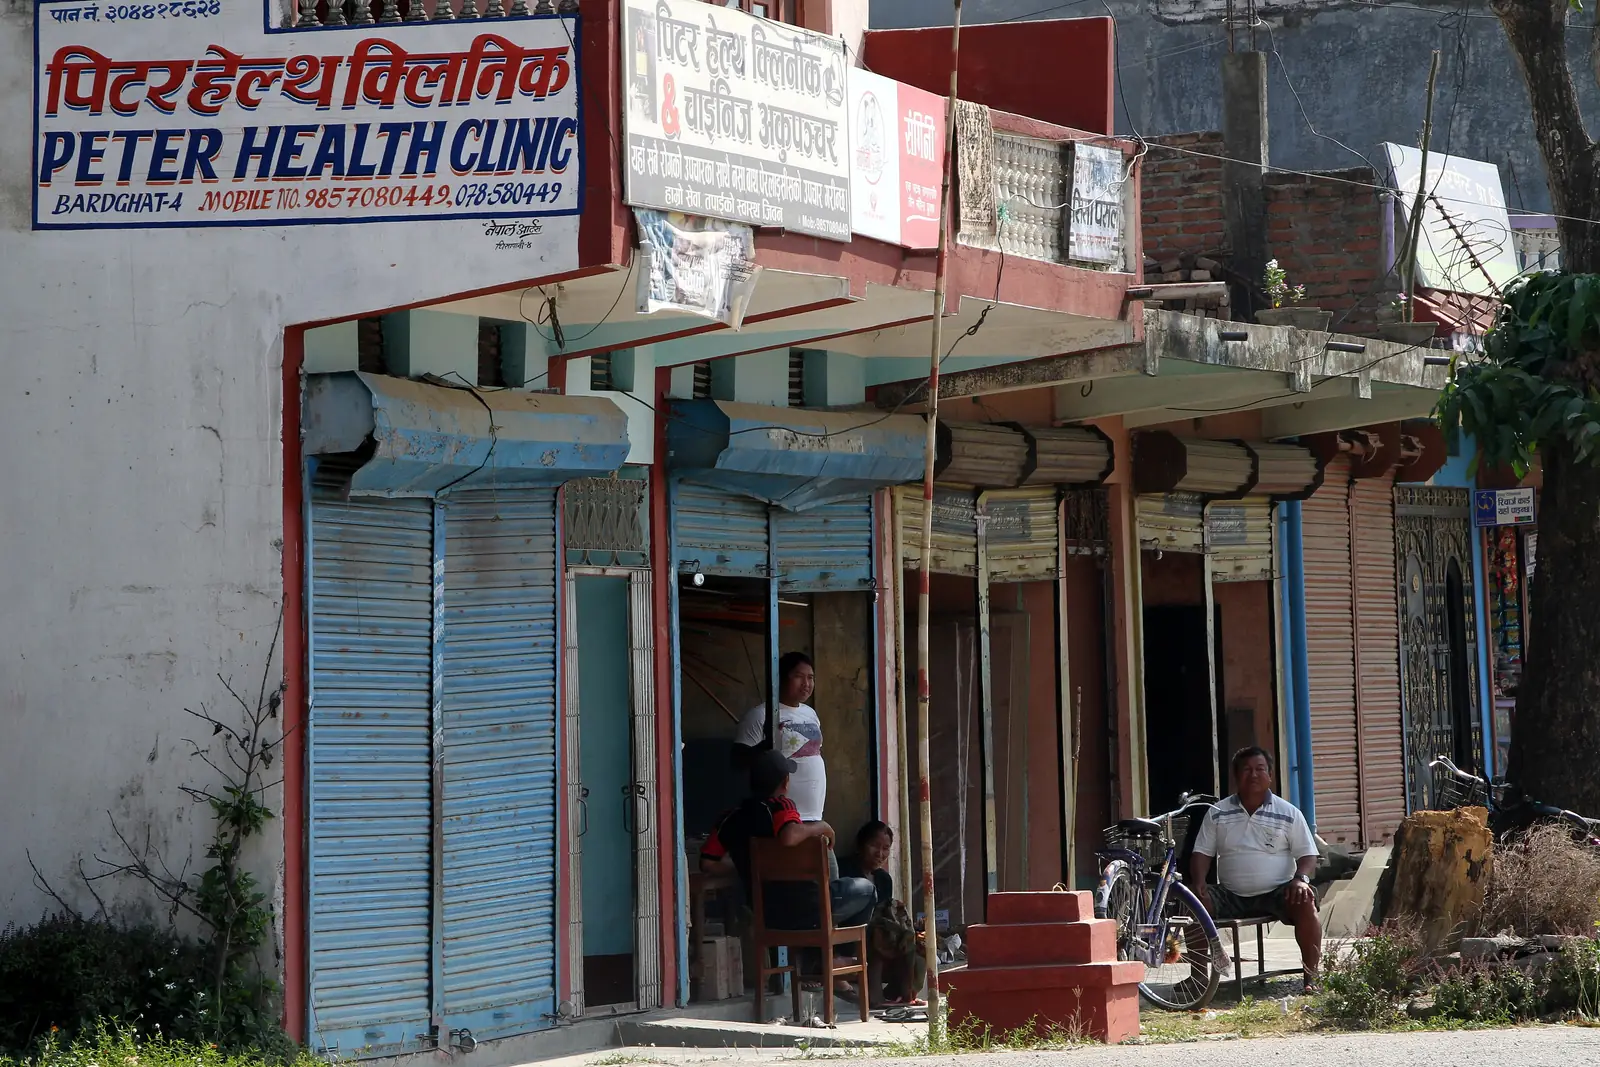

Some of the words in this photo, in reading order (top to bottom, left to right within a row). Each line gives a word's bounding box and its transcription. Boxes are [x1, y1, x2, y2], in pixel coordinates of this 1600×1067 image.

[50, 8, 82, 24] पान
[656, 0, 701, 73] पिटर
[705, 13, 747, 80] हेल्थ
[45, 44, 195, 116] पिटर
[187, 44, 343, 115] हेल्थ
[342, 33, 572, 110] क्लिनिक
[661, 73, 681, 139] &
[39, 127, 224, 188] PETER
[232, 120, 449, 183] HEALTH
[449, 115, 579, 178] CLINIC
[51, 192, 183, 215] BARDGHAT-4
[198, 189, 275, 212] MOBILE
[276, 188, 301, 209] NO.
